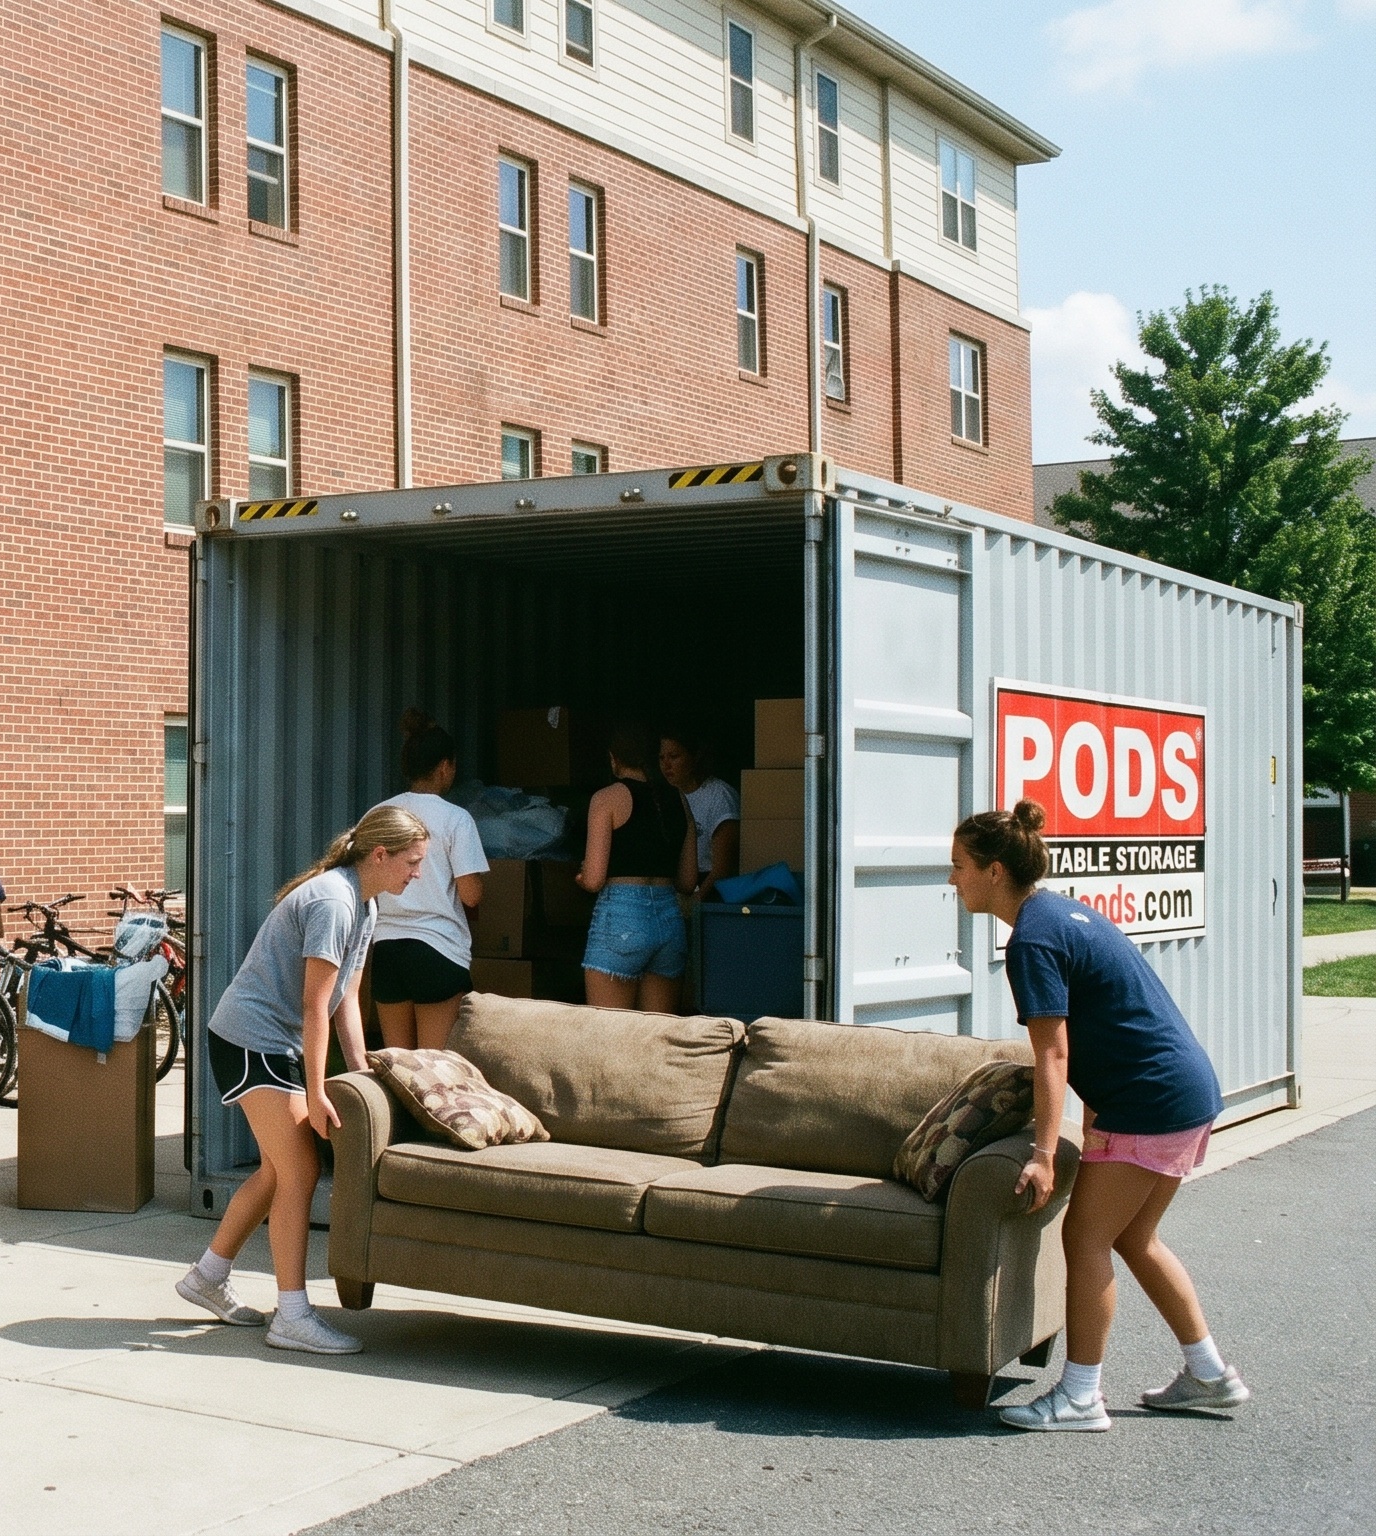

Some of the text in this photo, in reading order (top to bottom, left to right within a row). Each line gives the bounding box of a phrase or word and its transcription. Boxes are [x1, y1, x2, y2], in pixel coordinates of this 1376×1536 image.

[1004, 714, 1199, 821] PODS
[1049, 845, 1197, 874] TABLE STORAGE
